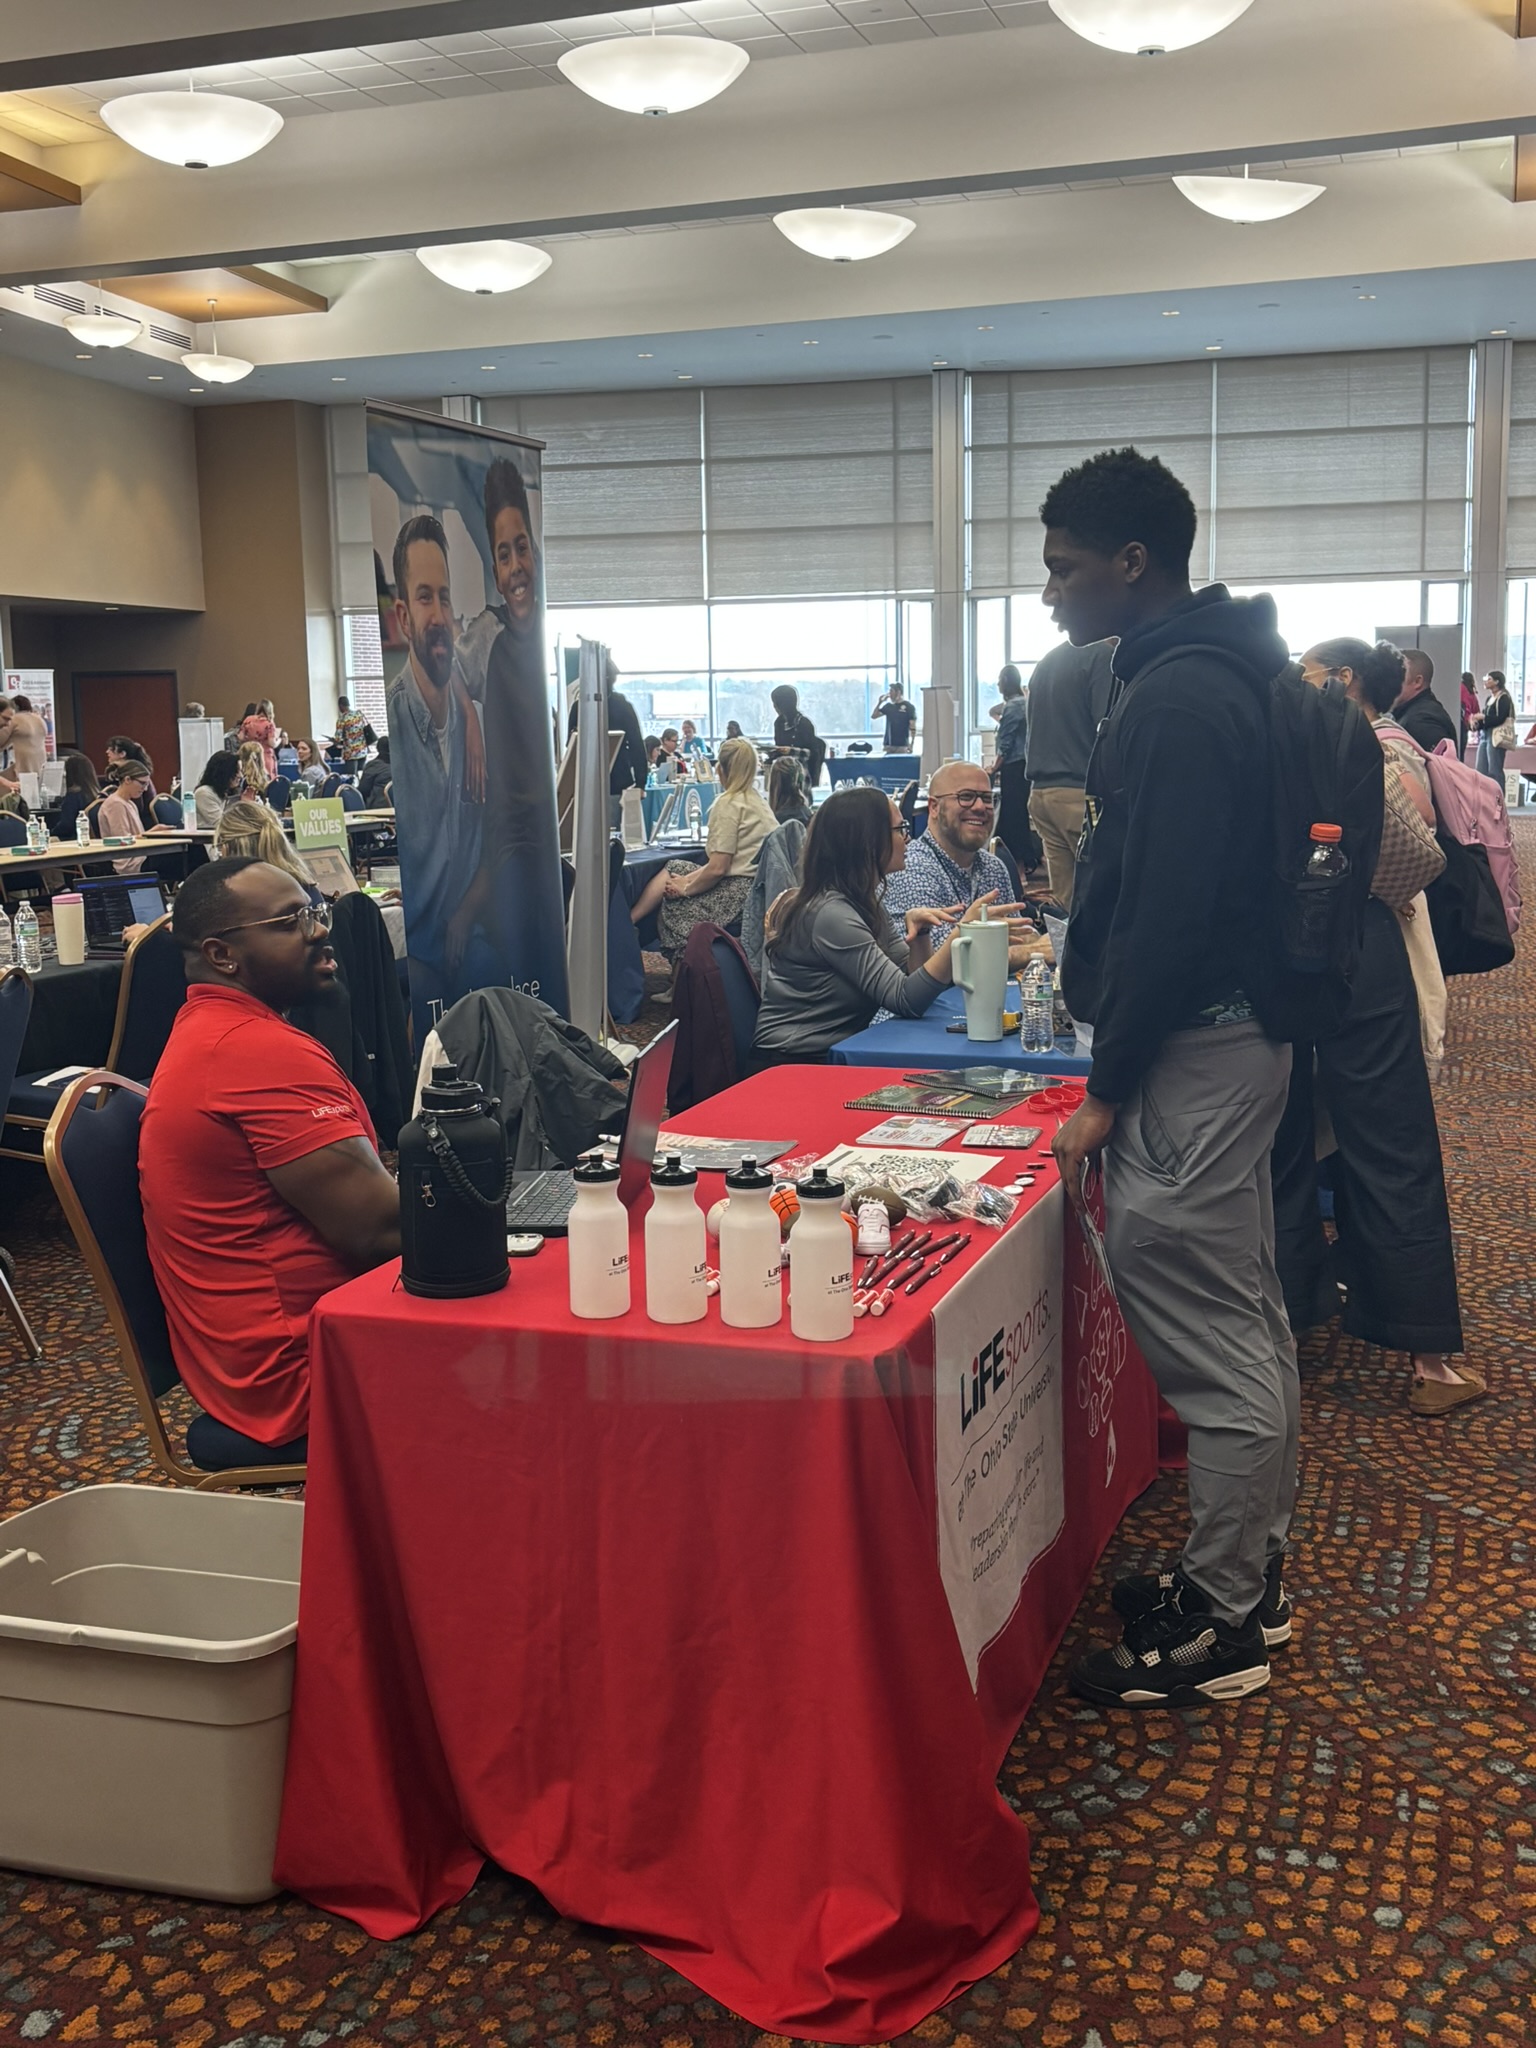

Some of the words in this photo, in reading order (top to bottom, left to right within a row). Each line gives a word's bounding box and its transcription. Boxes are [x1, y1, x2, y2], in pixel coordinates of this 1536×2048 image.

[309, 808, 328, 820] OUR
[299, 819, 342, 837] VALUES
[980, 1438, 1002, 1479] Ohio
